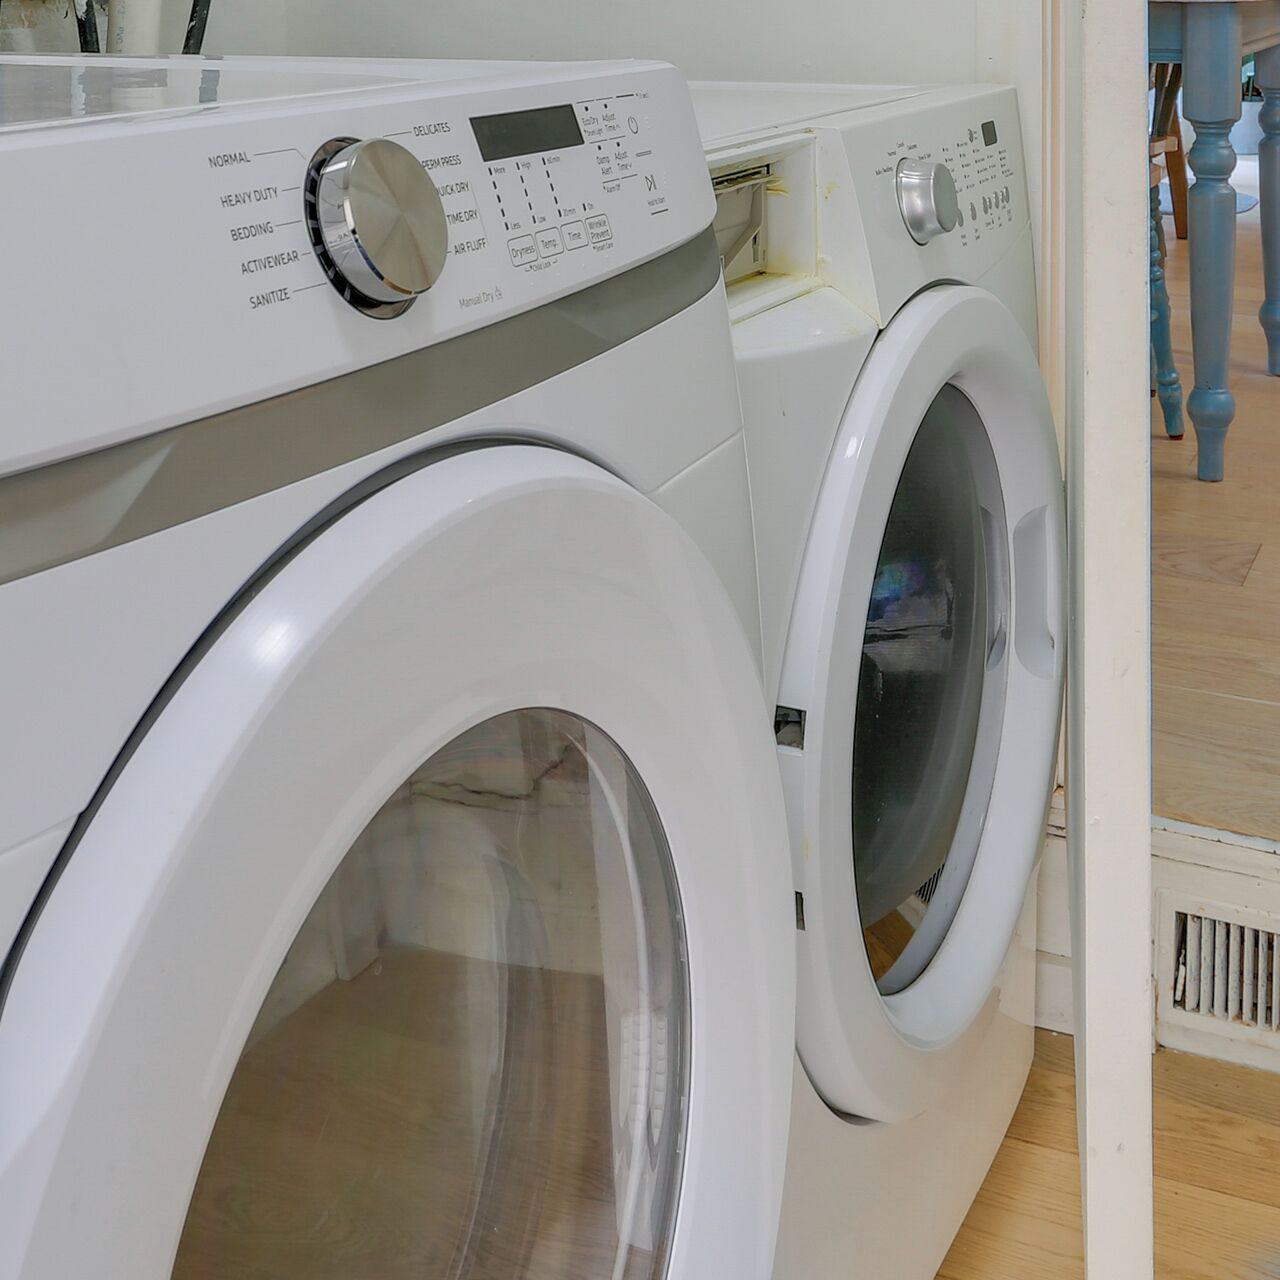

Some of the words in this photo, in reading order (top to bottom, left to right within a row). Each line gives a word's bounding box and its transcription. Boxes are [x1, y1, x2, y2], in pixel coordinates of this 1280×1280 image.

[413, 122, 451, 137] DELICATES
[208, 151, 252, 169] NORMAL
[421, 157, 441, 170] PERM
[441, 154, 462, 167] PRESS
[521, 161, 531, 171] High
[219, 190, 253, 208] HEAVY
[253, 186, 279, 203] DUTY
[437, 183, 455, 198] UICK
[455, 181, 470, 194] DRY
[446, 212, 464, 225] TIME
[463, 209, 478, 223] DRY
[230, 220, 274, 242] BEDDING
[510, 222, 521, 230] Less
[567, 231, 582, 241] Time
[590, 229, 610, 240] Prevent
[453, 243, 467, 256] AIR
[467, 237, 487, 253] FLUFF
[511, 245, 536, 259] Dryness
[241, 249, 300, 275] ACTIVEWEAR
[249, 287, 291, 309] SANITIZE
[458, 292, 482, 309] Manual
[482, 289, 496, 303] Dry
